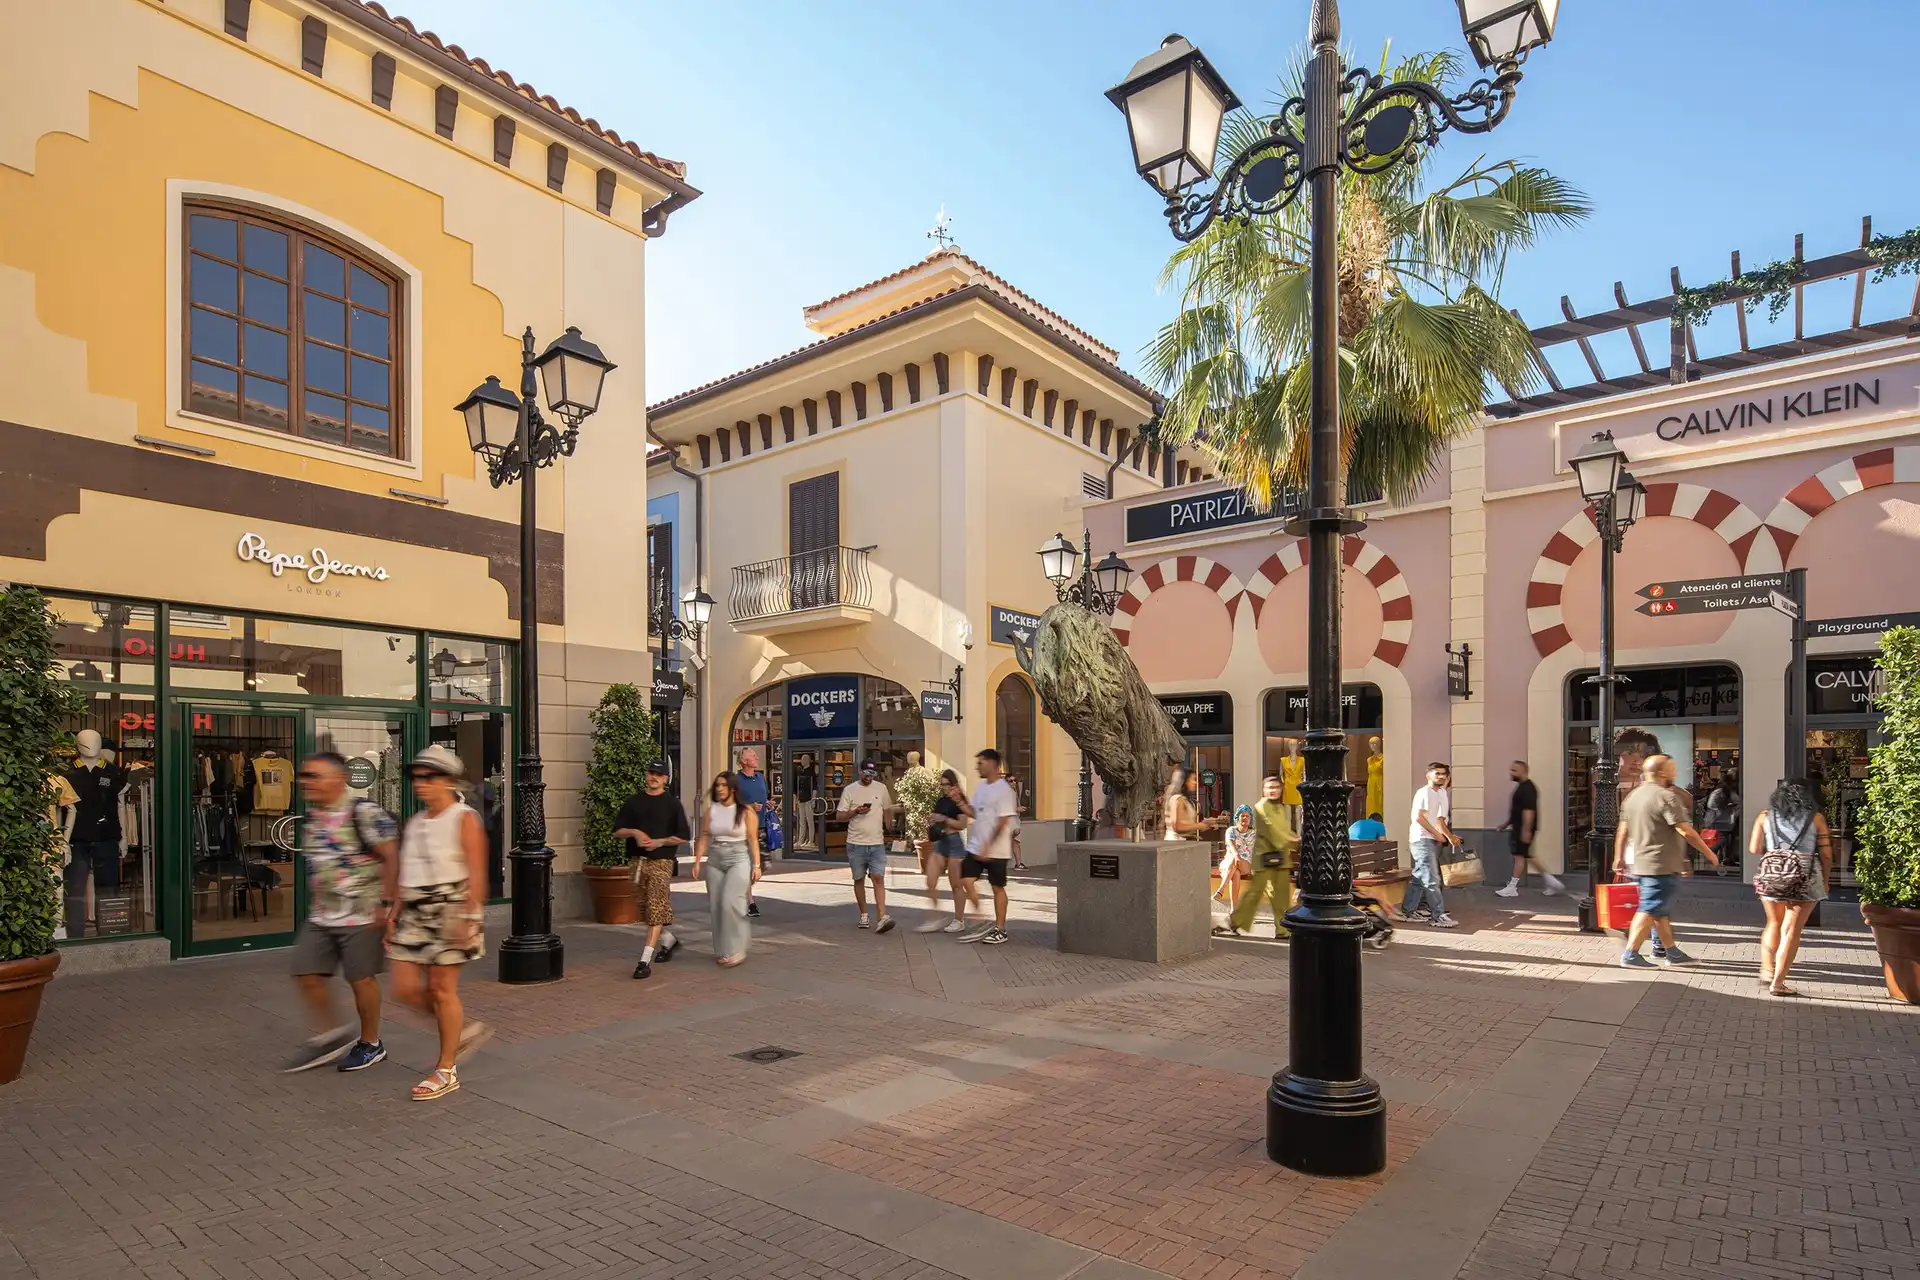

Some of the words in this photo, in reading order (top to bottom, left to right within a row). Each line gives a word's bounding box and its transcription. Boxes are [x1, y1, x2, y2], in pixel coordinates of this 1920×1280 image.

[1656, 398, 1773, 441] CALVIN
[1783, 378, 1881, 421] KLEIN
[238, 532, 309, 577] Pepe
[308, 548, 391, 583] Jeans
[287, 584, 342, 598] LONDON
[1680, 582, 1728, 594] Atención
[1731, 581, 1741, 590] al
[1744, 578, 1782, 588] cliente
[1703, 598, 1740, 608] Toilets
[1749, 595, 1769, 604] Ase
[1817, 619, 1889, 634] Playground
[791, 689, 855, 707] DOCKERS
[924, 697, 950, 706] DOCKERS
[1194, 703, 1215, 714] PEPE
